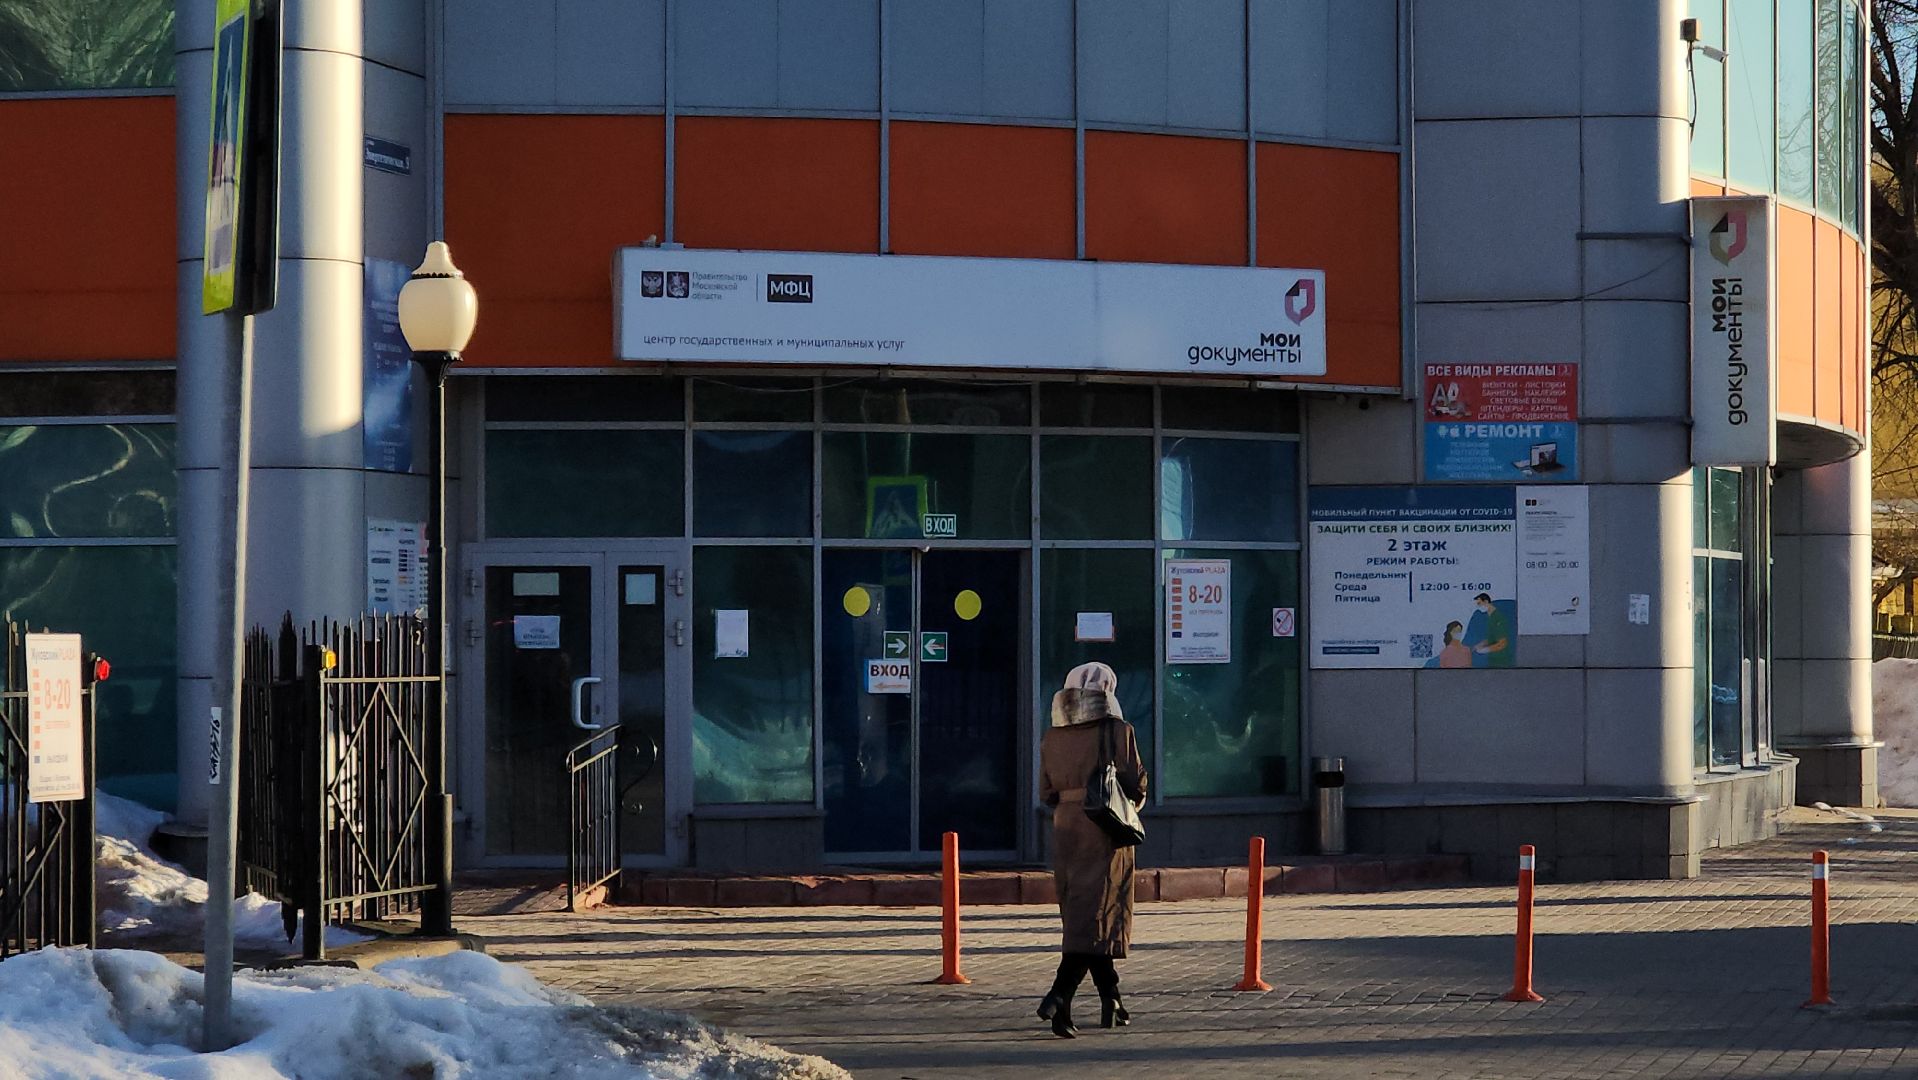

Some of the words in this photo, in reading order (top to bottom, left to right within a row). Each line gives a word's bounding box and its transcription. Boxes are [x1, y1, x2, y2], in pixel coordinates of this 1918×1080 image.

[692, 272, 748, 282] Правительство
[692, 281, 738, 291] Московской
[770, 280, 811, 298] МФЦ
[1711, 278, 1727, 332] мои
[643, 334, 676, 347] центр
[679, 336, 773, 348] государственных
[776, 338, 784, 347] и
[787, 338, 875, 350] муниципальных
[877, 339, 905, 351] услуг
[1260, 332, 1301, 347] мои
[1187, 346, 1301, 366] документы
[1728, 278, 1748, 427] документы
[1427, 365, 1451, 376] ВСЕ
[1455, 366, 1492, 378] ВИДЫ
[1495, 365, 1556, 376] РЕКЛАМЫ
[1464, 425, 1544, 438] РЕМОНТ
[1311, 508, 1367, 517] МОБИЛЬНЫЙ
[1369, 508, 1396, 516] ПУНКТ
[1400, 508, 1457, 517] ВАКЦИНАЦИИ
[1459, 508, 1471, 516] ОТ
[1473, 508, 1513, 516] COVID-19
[925, 516, 955, 535] ВХОД
[1317, 525, 1366, 534] ЗАЩИТИ
[1369, 525, 1398, 534] СЕБЯ
[1401, 525, 1409, 533] И
[1413, 524, 1451, 533] СВОИХ
[1454, 524, 1512, 533] БЛИЗКИХ!
[1387, 539, 1397, 551] 2
[1403, 540, 1448, 552] этаж
[1366, 557, 1407, 566] РЕЖИМ
[1410, 557, 1459, 566] РАБОТЫ:
[1334, 571, 1408, 580] Понедельник
[1334, 583, 1367, 592] Среда
[1419, 583, 1450, 591] 12:00
[1461, 582, 1492, 591] 16:00
[1188, 585, 1222, 604] 8-20
[1334, 594, 1381, 604] Пятница
[870, 664, 910, 681] ВХОД
